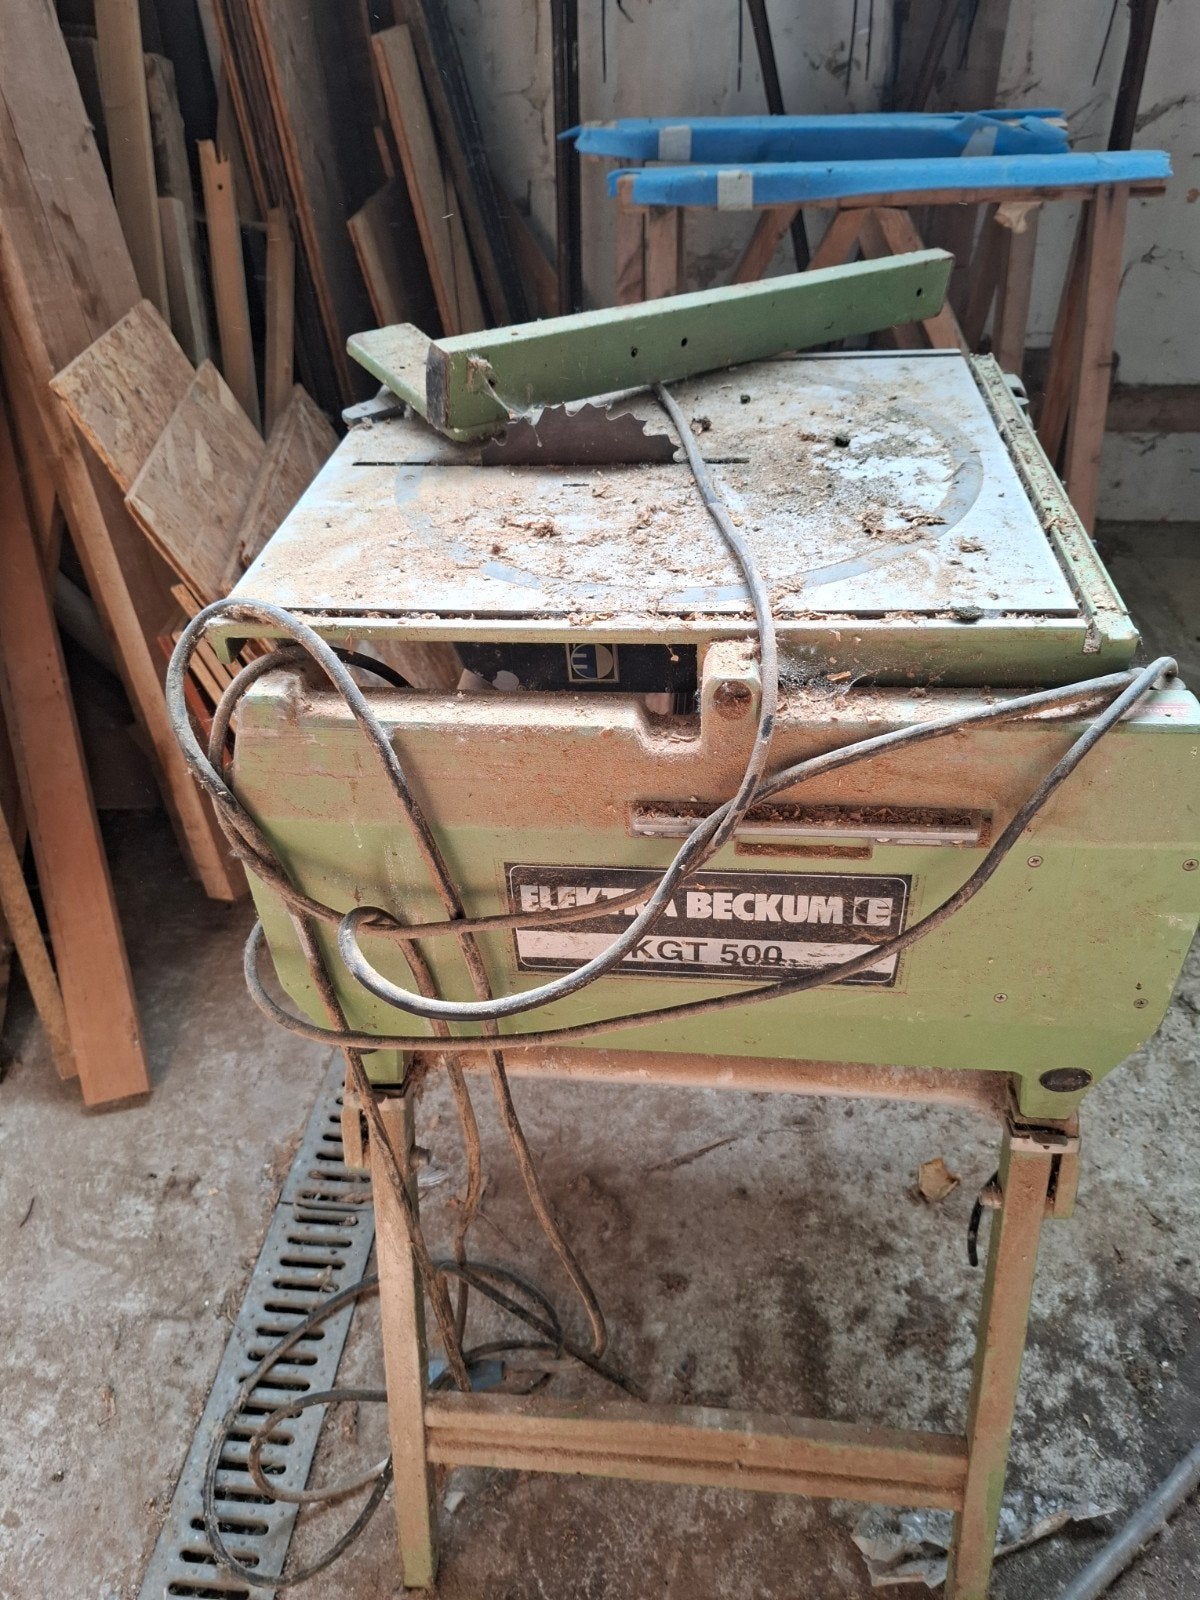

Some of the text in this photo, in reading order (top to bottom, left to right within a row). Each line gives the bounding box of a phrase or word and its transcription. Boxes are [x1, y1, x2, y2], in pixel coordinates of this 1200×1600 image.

[686, 892, 843, 924] BECKUM
[631, 939, 783, 965] KGT 500
